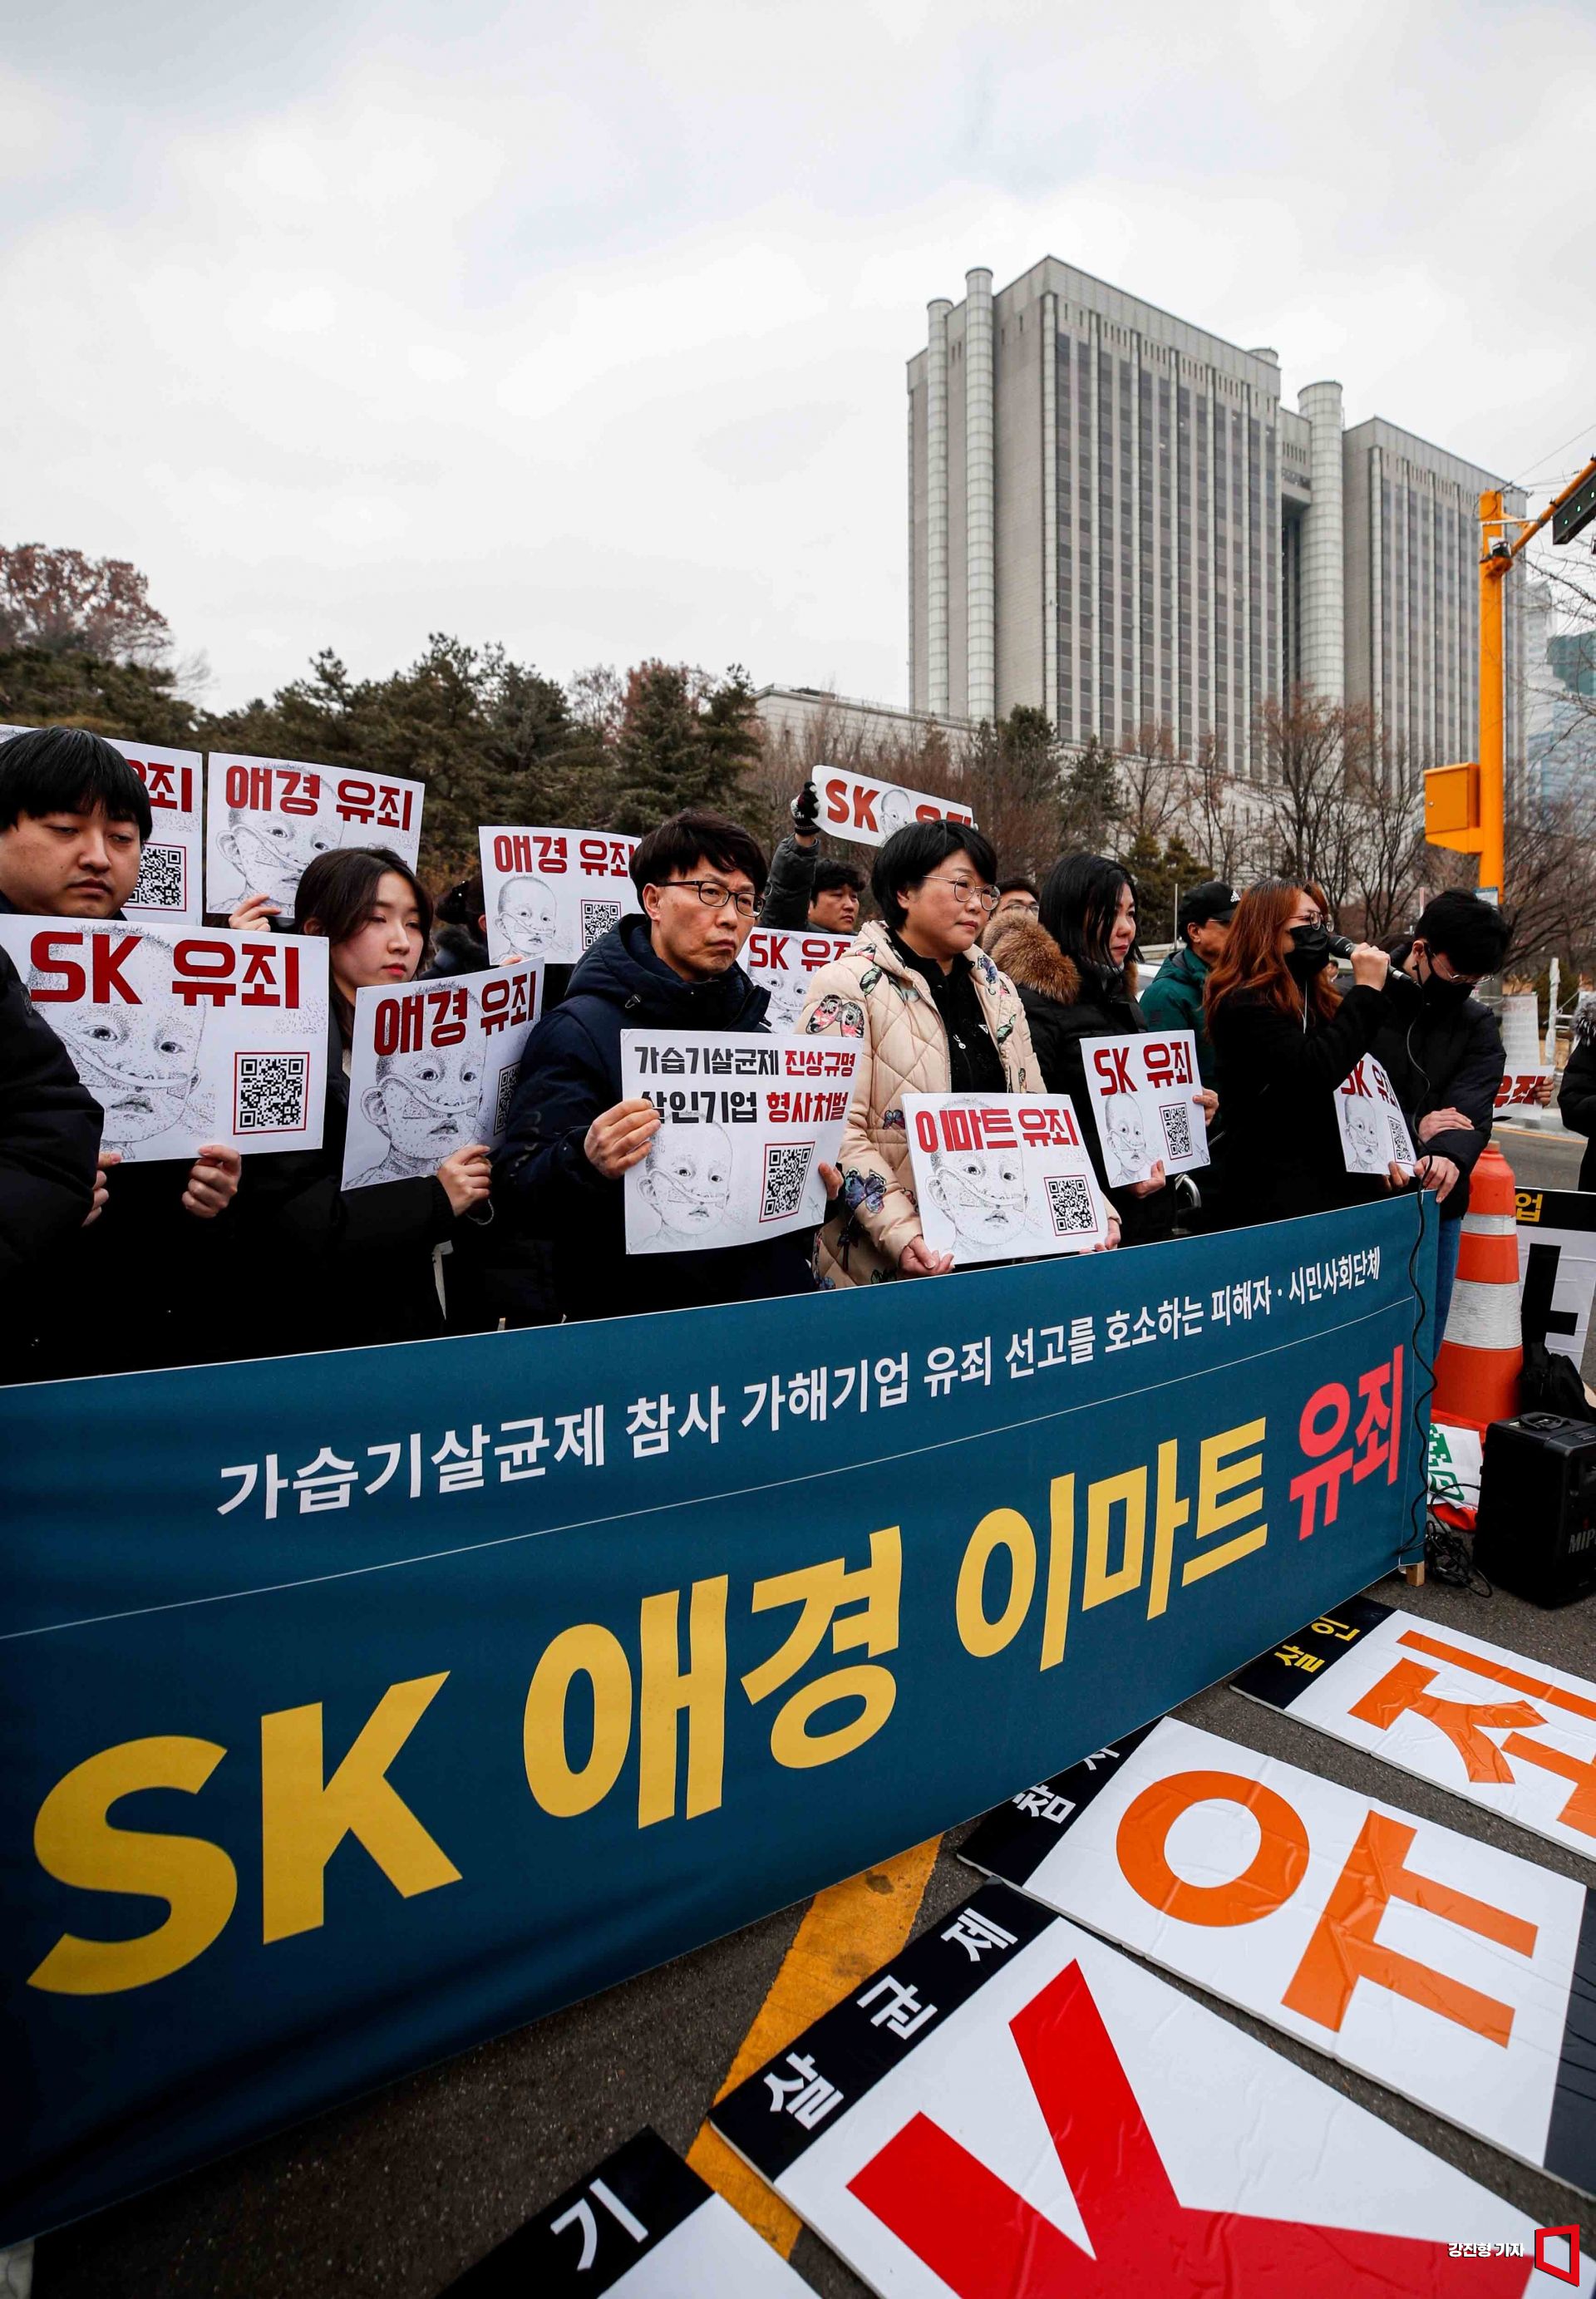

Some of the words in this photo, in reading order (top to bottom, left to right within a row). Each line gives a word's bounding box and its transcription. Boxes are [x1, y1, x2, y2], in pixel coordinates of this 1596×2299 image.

[126, 759, 193, 813] 죄
[225, 765, 321, 816] 애경
[336, 779, 413, 830] 유죄
[825, 779, 879, 833] SK
[494, 834, 569, 874] 애경
[579, 839, 636, 878] 유죄
[29, 930, 142, 1006] SK
[172, 939, 300, 1010] 유죄
[749, 933, 790, 970] SK
[373, 988, 467, 1056] 애경
[480, 971, 536, 1036] 유죄
[634, 1046, 779, 1076] 가습기살균제
[784, 1050, 856, 1078] 진상규명
[1093, 1047, 1137, 1097] SK
[1143, 1041, 1194, 1089] 유죄
[766, 1090, 849, 1124] 형사처벌
[915, 1109, 1018, 1153] 이마트
[1017, 1109, 1080, 1147] 유죄
[1515, 1193, 1544, 1223] 업
[217, 1404, 605, 1520] 가습기살균제
[625, 1385, 726, 1459] 참사
[741, 1351, 909, 1431] 가해기업
[924, 1336, 992, 1398] 유죄
[1005, 1315, 1096, 1379] 선고를
[1106, 1296, 1204, 1354] 호소하는
[1211, 1275, 1272, 1327] 피해자
[1288, 1245, 1381, 1306] 시민사회단체
[1568, 1529, 1596, 1554] MIP
[27, 1671, 462, 1994] SK
[524, 1526, 902, 1828] 애경
[955, 1416, 1268, 1672] 이마트
[1289, 1344, 1404, 1540] 유죄
[1273, 1616, 1361, 1674] 살인
[1116, 1770, 1539, 2050] 유
[763, 1908, 1018, 2130] 살균제
[549, 2178, 649, 2272] 기
